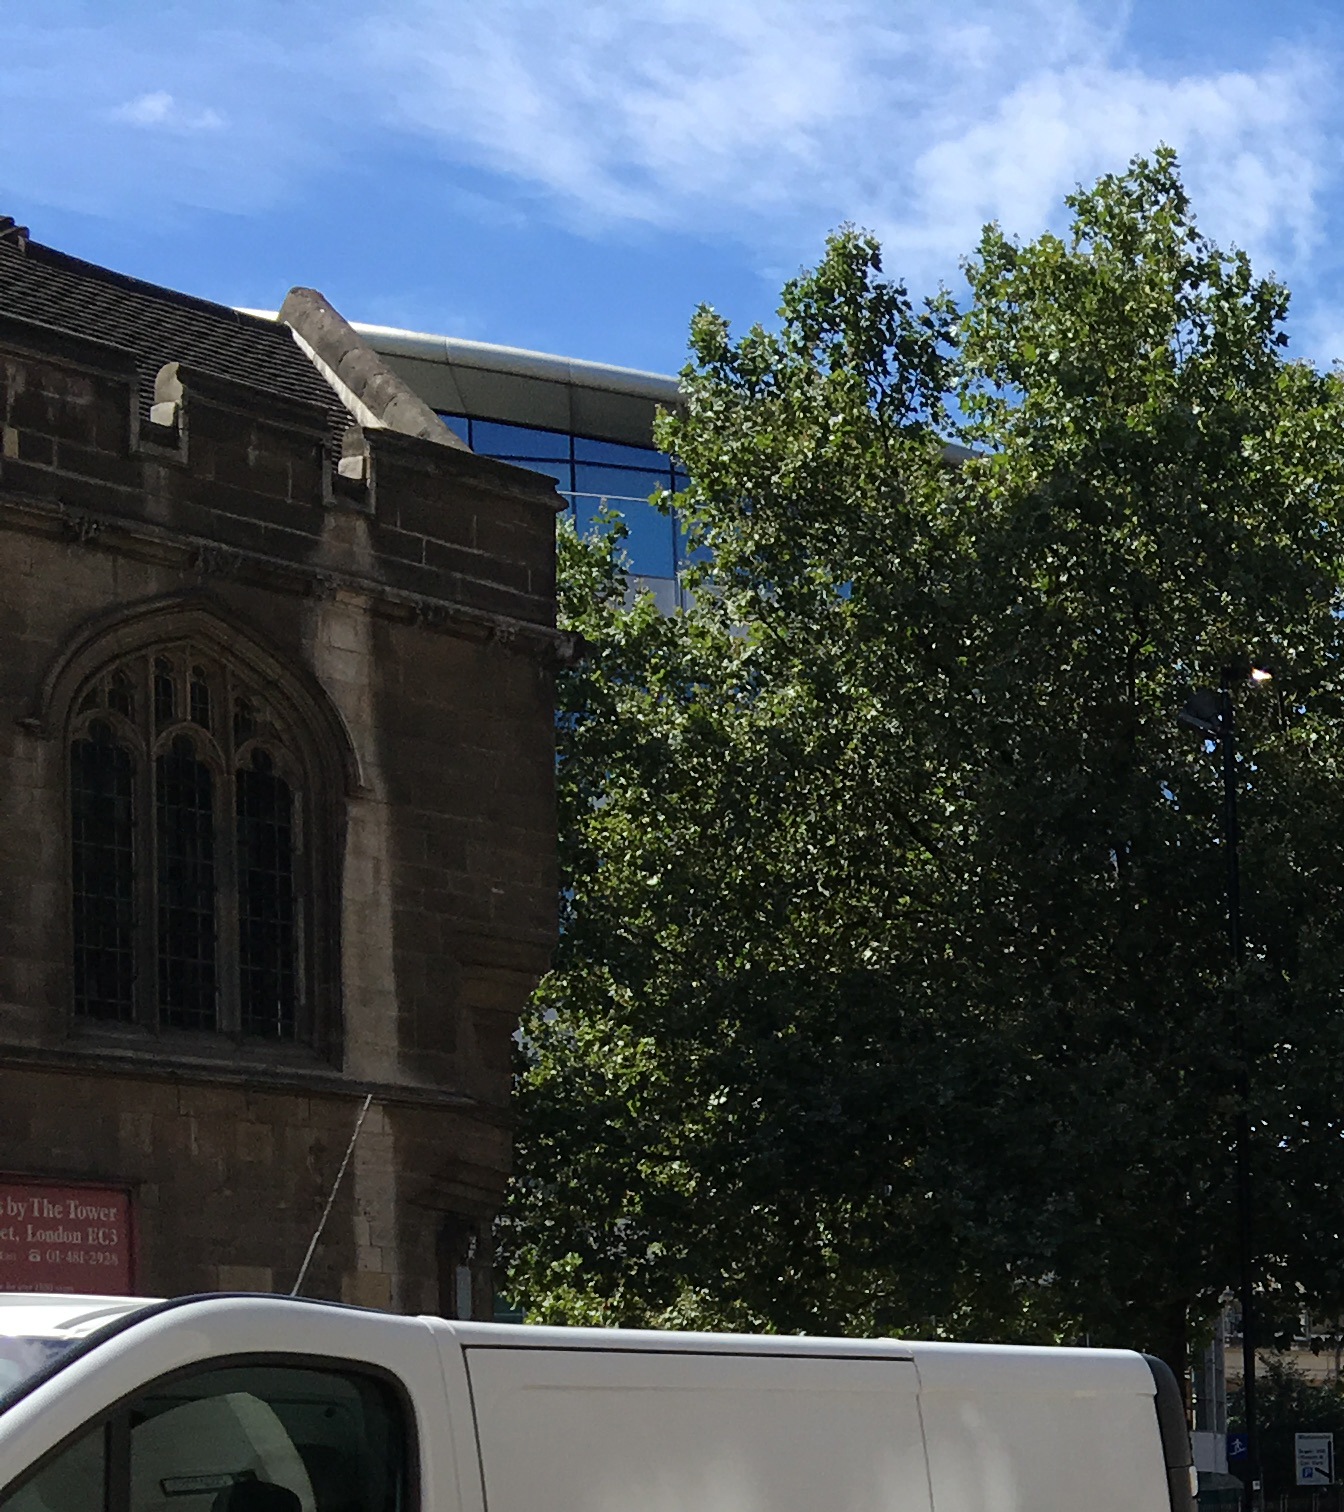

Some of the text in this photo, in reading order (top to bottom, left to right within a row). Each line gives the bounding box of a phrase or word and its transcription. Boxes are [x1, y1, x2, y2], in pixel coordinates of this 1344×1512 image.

[6, 1196, 27, 1221] by
[30, 1197, 63, 1219] The
[67, 1199, 118, 1221] Tower
[26, 1223, 82, 1244] London
[87, 1226, 118, 1246] EC3
